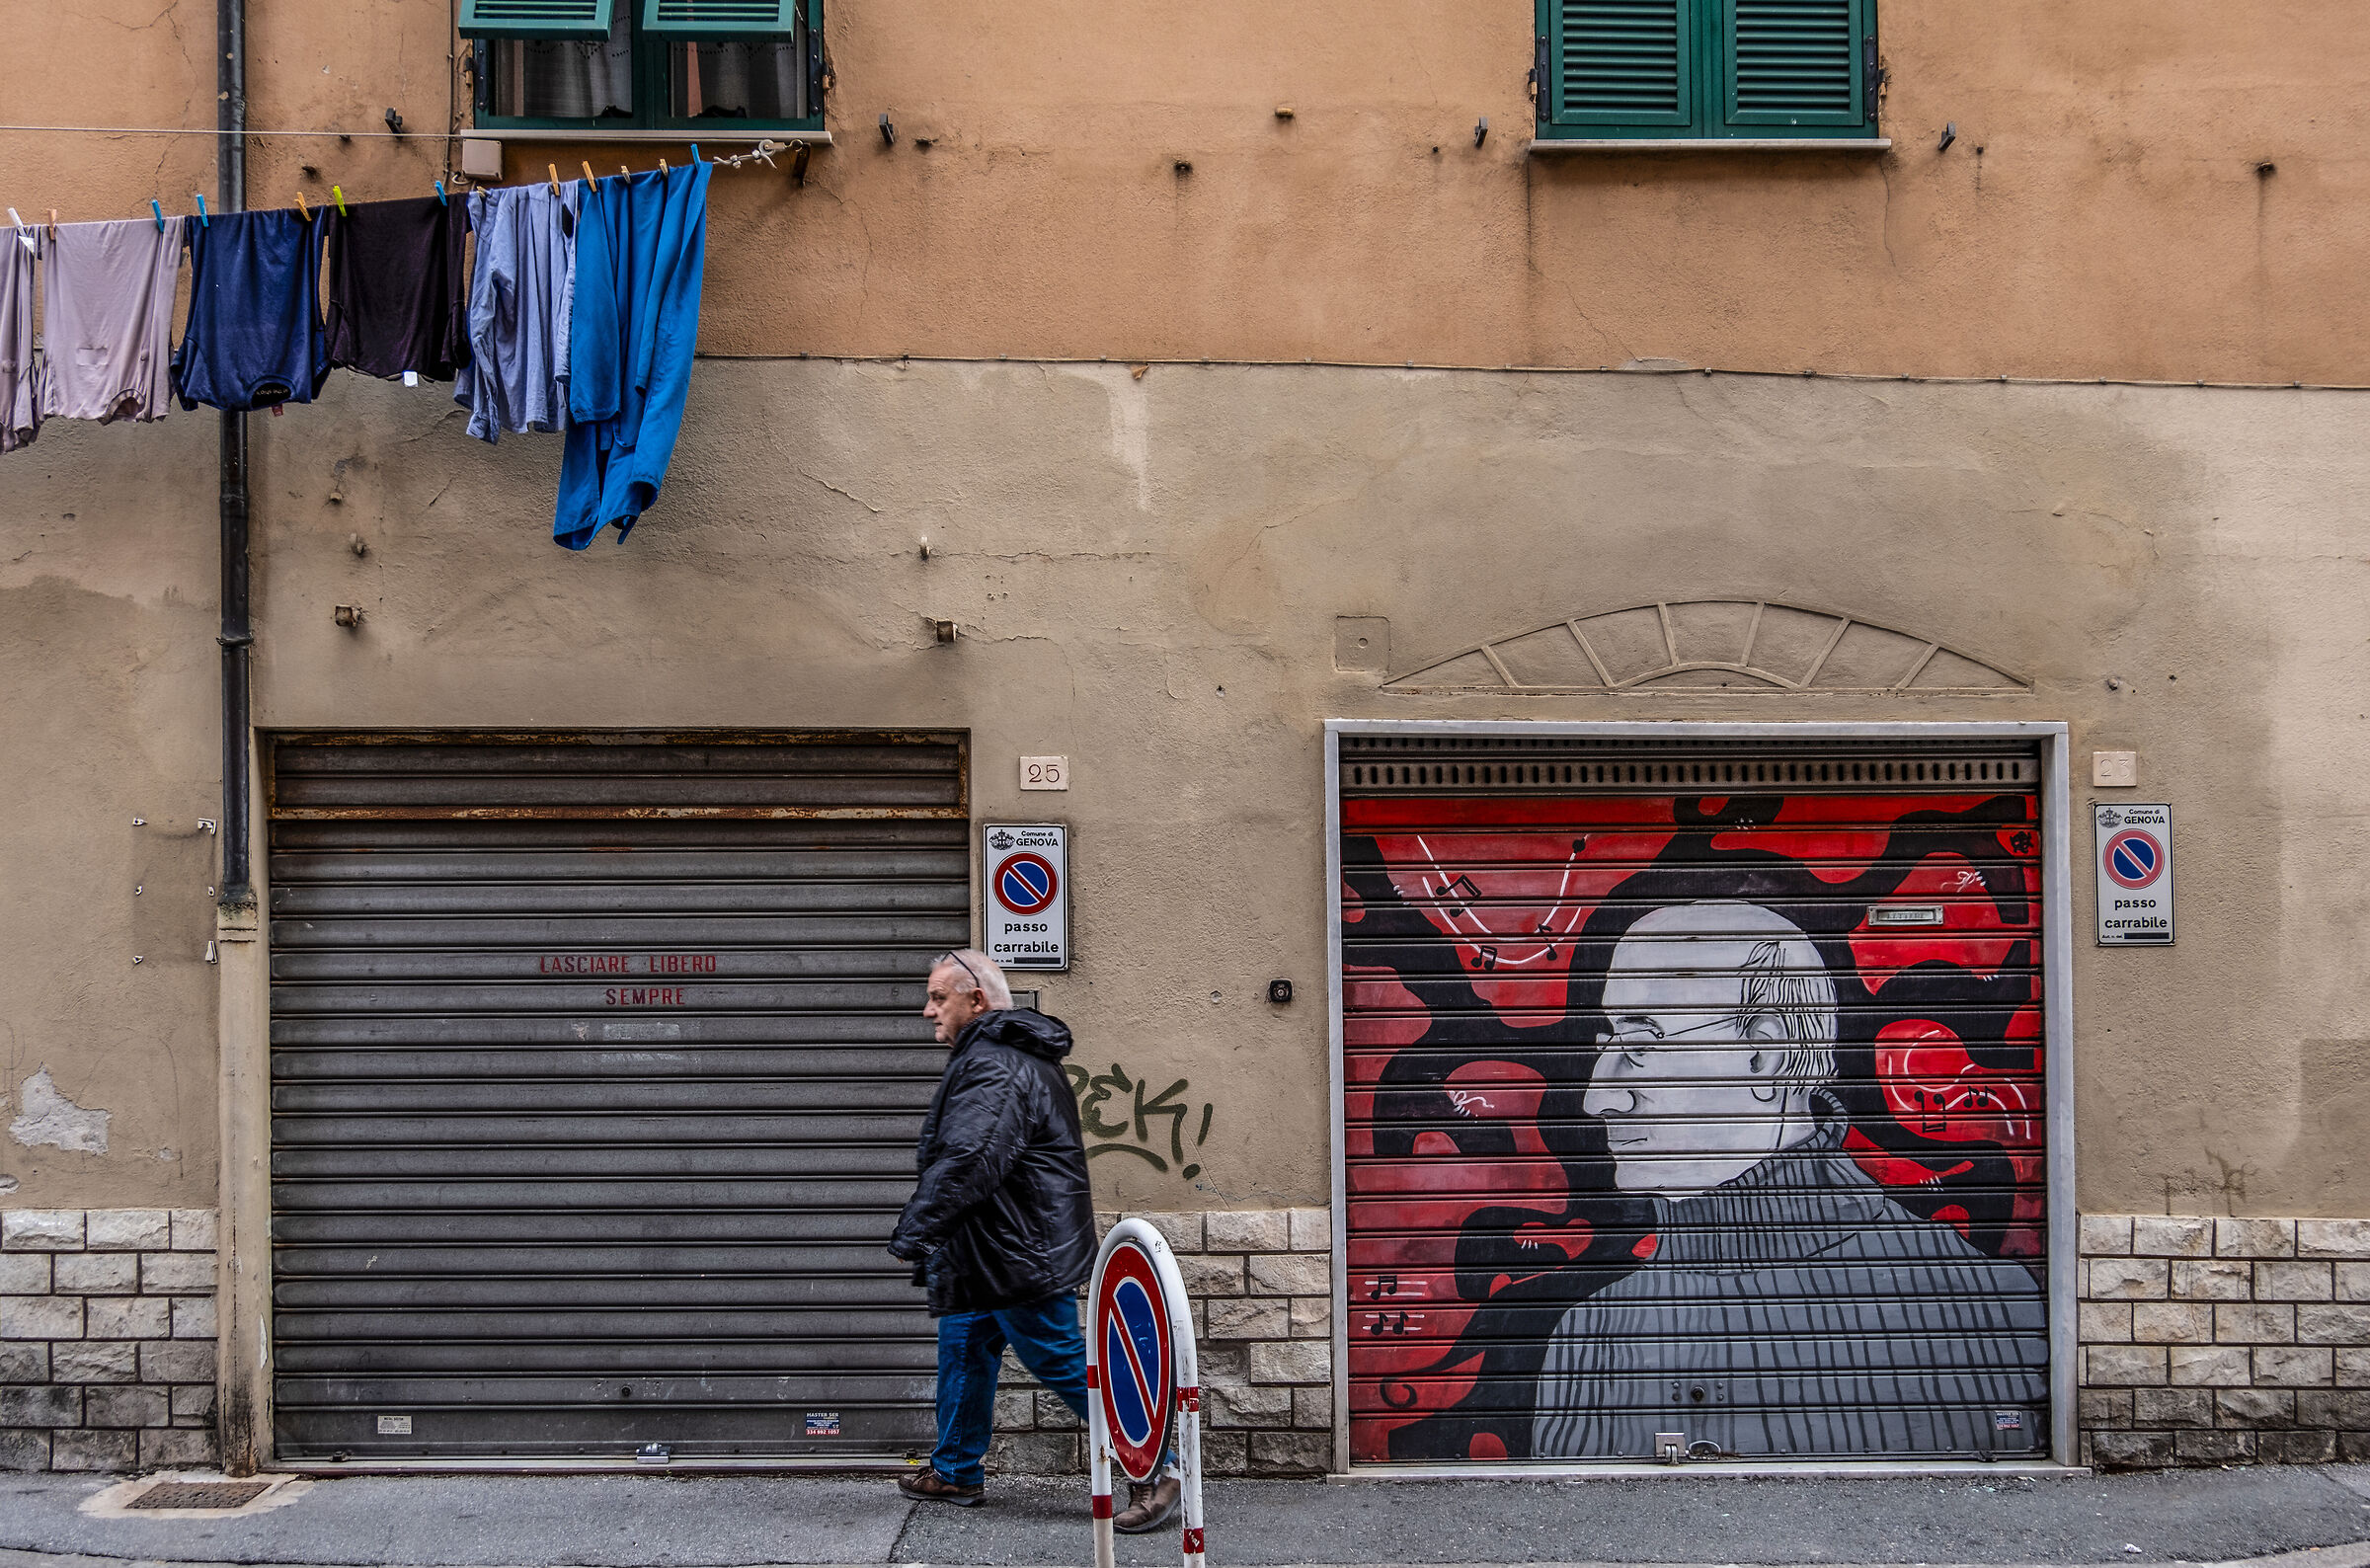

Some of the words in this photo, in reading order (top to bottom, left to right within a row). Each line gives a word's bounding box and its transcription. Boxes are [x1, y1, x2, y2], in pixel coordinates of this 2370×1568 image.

[1028, 763, 1061, 783] 25
[2100, 758, 2131, 778] 23
[2124, 816, 2166, 824] GENOVA
[1016, 838, 1059, 847] GENOVA
[2114, 900, 2157, 910] passo
[1004, 922, 1049, 934] passo
[2104, 917, 2168, 928] carrabile
[993, 941, 1060, 953] carrabile
[540, 956, 630, 973] LASCIARE
[650, 956, 717, 973] LIBERO
[605, 987, 685, 1005] SEMPRE
